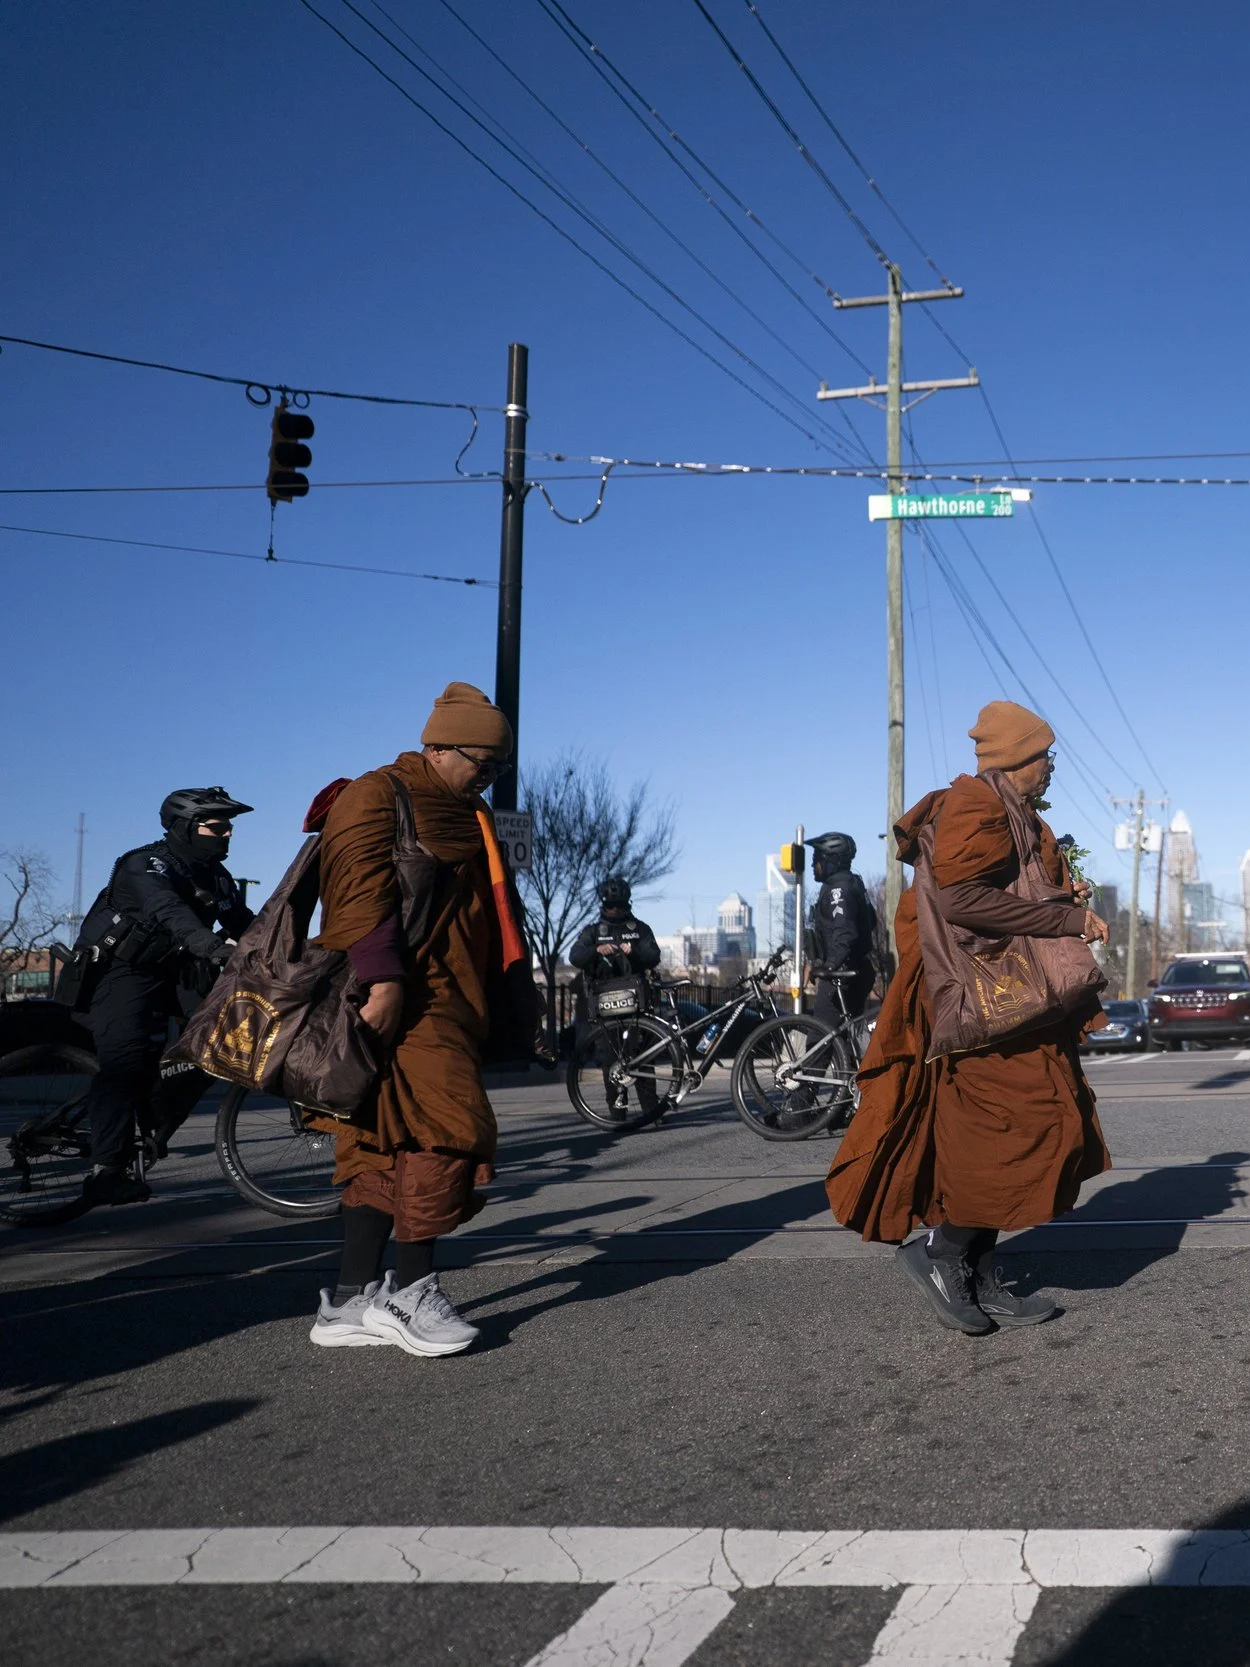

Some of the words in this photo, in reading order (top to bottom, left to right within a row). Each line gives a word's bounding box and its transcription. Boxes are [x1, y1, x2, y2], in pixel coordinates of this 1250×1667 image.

[897, 497, 985, 516] Hawthorne
[495, 816, 529, 828] SPEED
[499, 830, 525, 839] LIMIT
[599, 999, 635, 1010] POLICE
[160, 1062, 195, 1080] POLICE
[384, 1299, 412, 1326] HOKA
